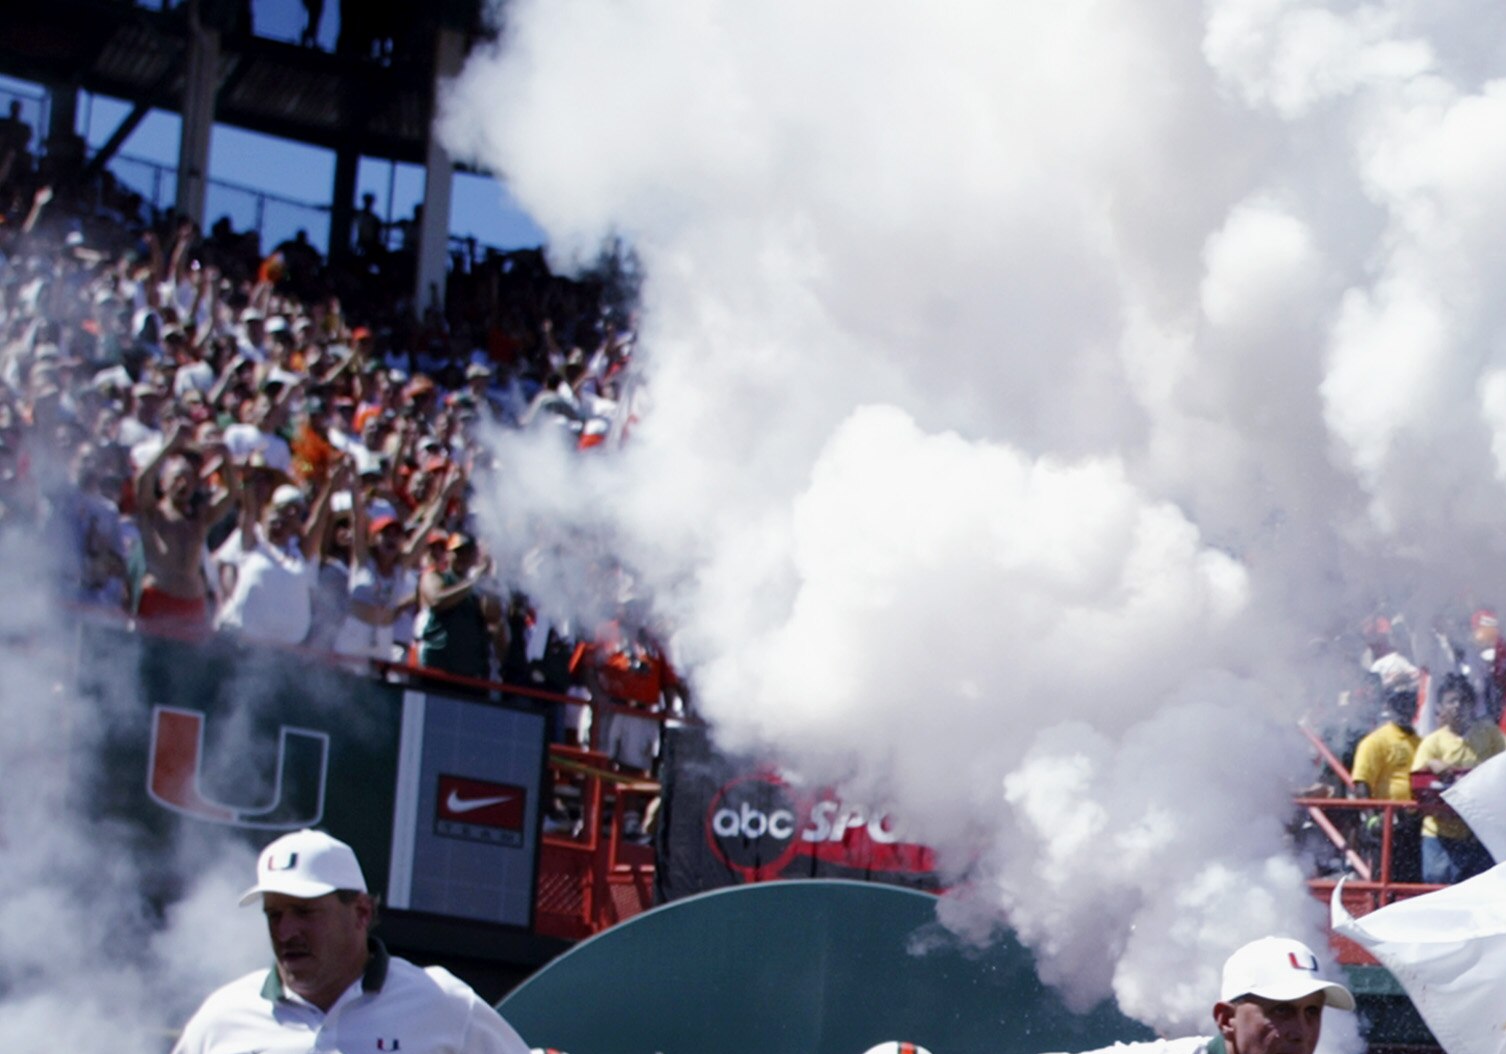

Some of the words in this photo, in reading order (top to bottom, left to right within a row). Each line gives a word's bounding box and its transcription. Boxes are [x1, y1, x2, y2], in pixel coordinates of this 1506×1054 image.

[148, 704, 330, 830] U
[713, 801, 795, 840] abc
[269, 852, 298, 872] U
[1288, 951, 1319, 972] U
[376, 1037, 400, 1053] U
